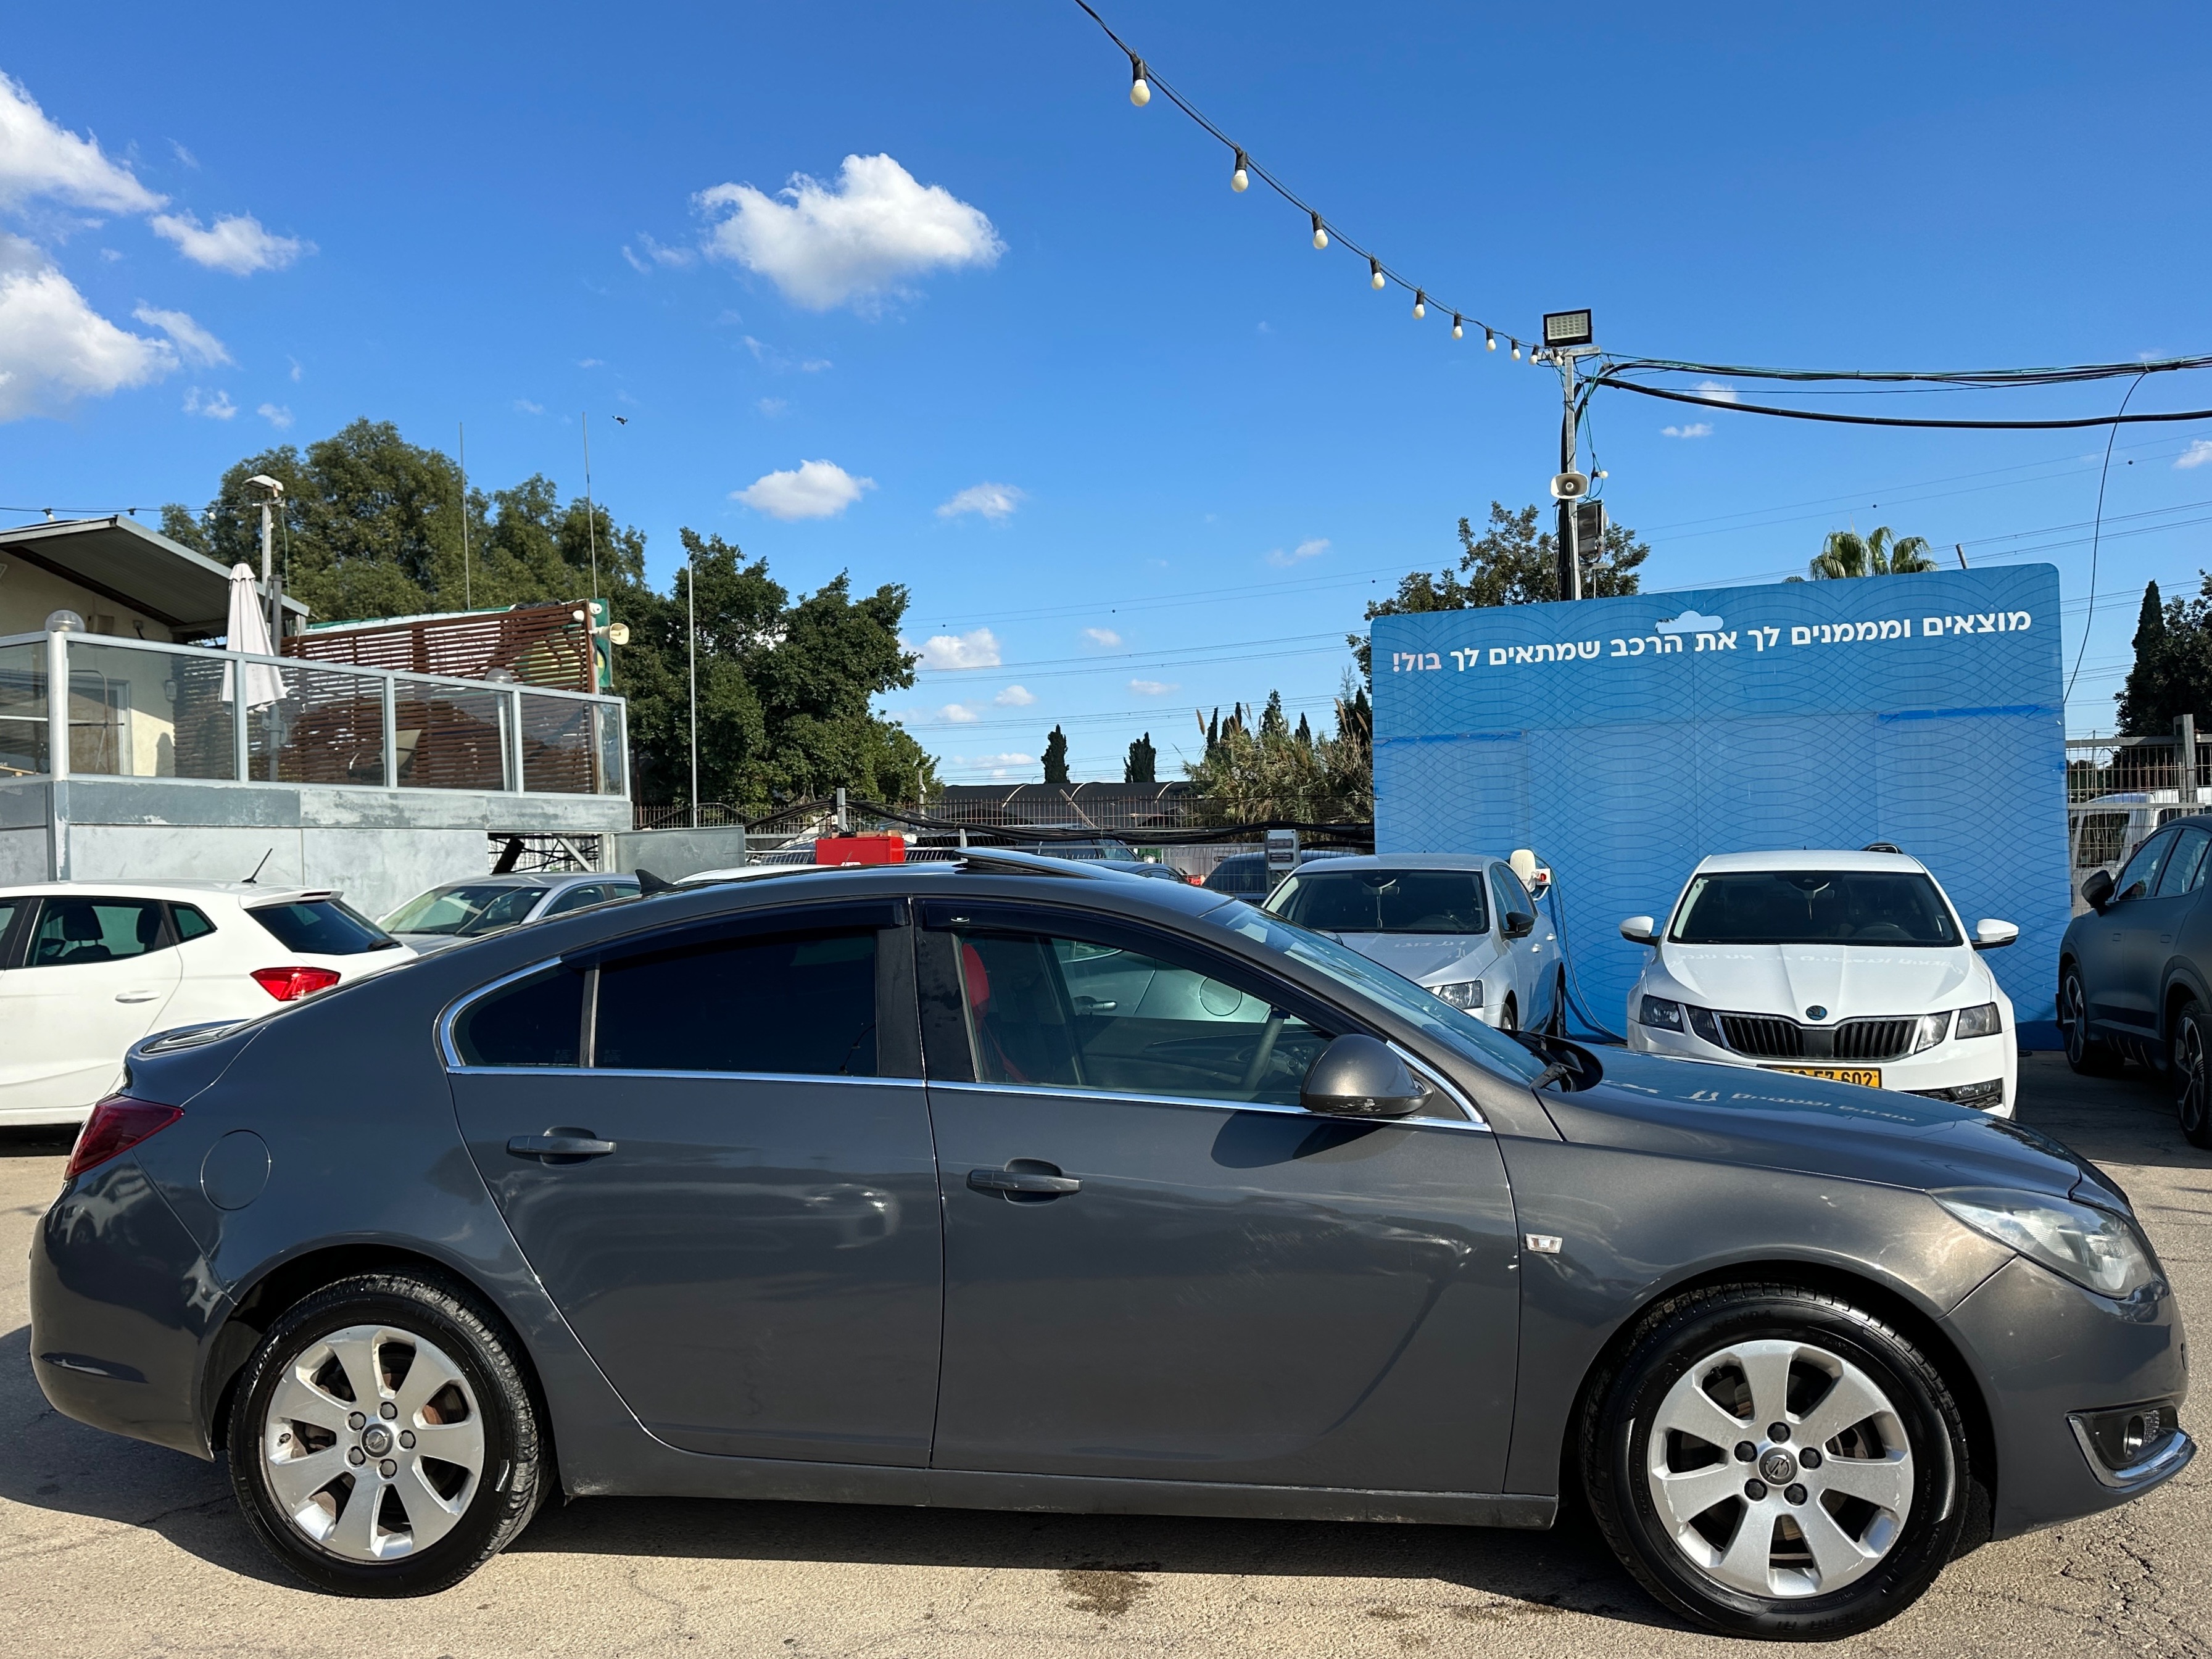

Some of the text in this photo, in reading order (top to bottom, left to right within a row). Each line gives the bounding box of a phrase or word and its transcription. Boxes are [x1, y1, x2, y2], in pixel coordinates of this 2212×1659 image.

[1392, 610, 2032, 673] מוצאים ומממנים לך את הרכב שמתאים לך בול!
